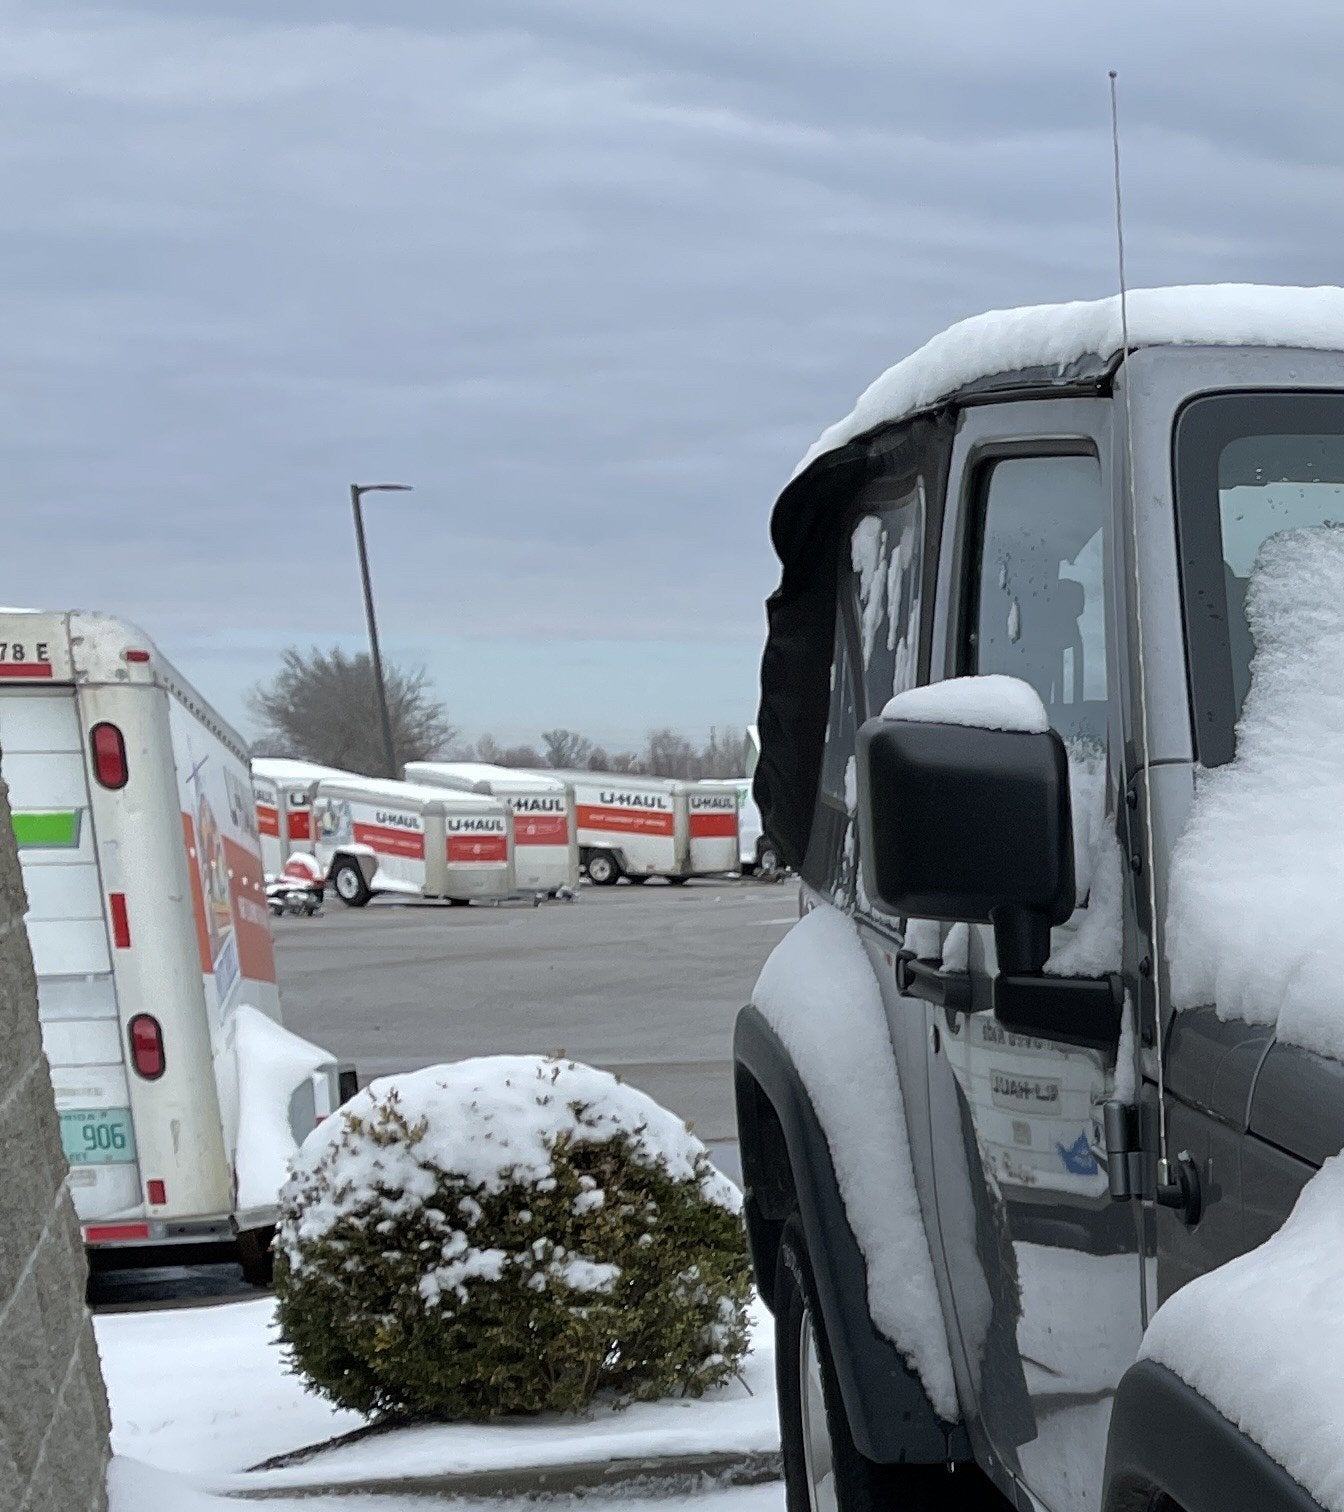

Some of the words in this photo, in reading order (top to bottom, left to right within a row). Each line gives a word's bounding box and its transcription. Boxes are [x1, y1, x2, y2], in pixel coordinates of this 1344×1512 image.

[36, 642, 50, 661] E
[511, 798, 565, 813] -HAUL
[600, 791, 668, 811] U-HAUL
[690, 797, 734, 810] U-HAUL
[375, 811, 421, 830] U-HAUL
[447, 817, 505, 832] U-HAUL
[81, 1122, 127, 1151] 906
